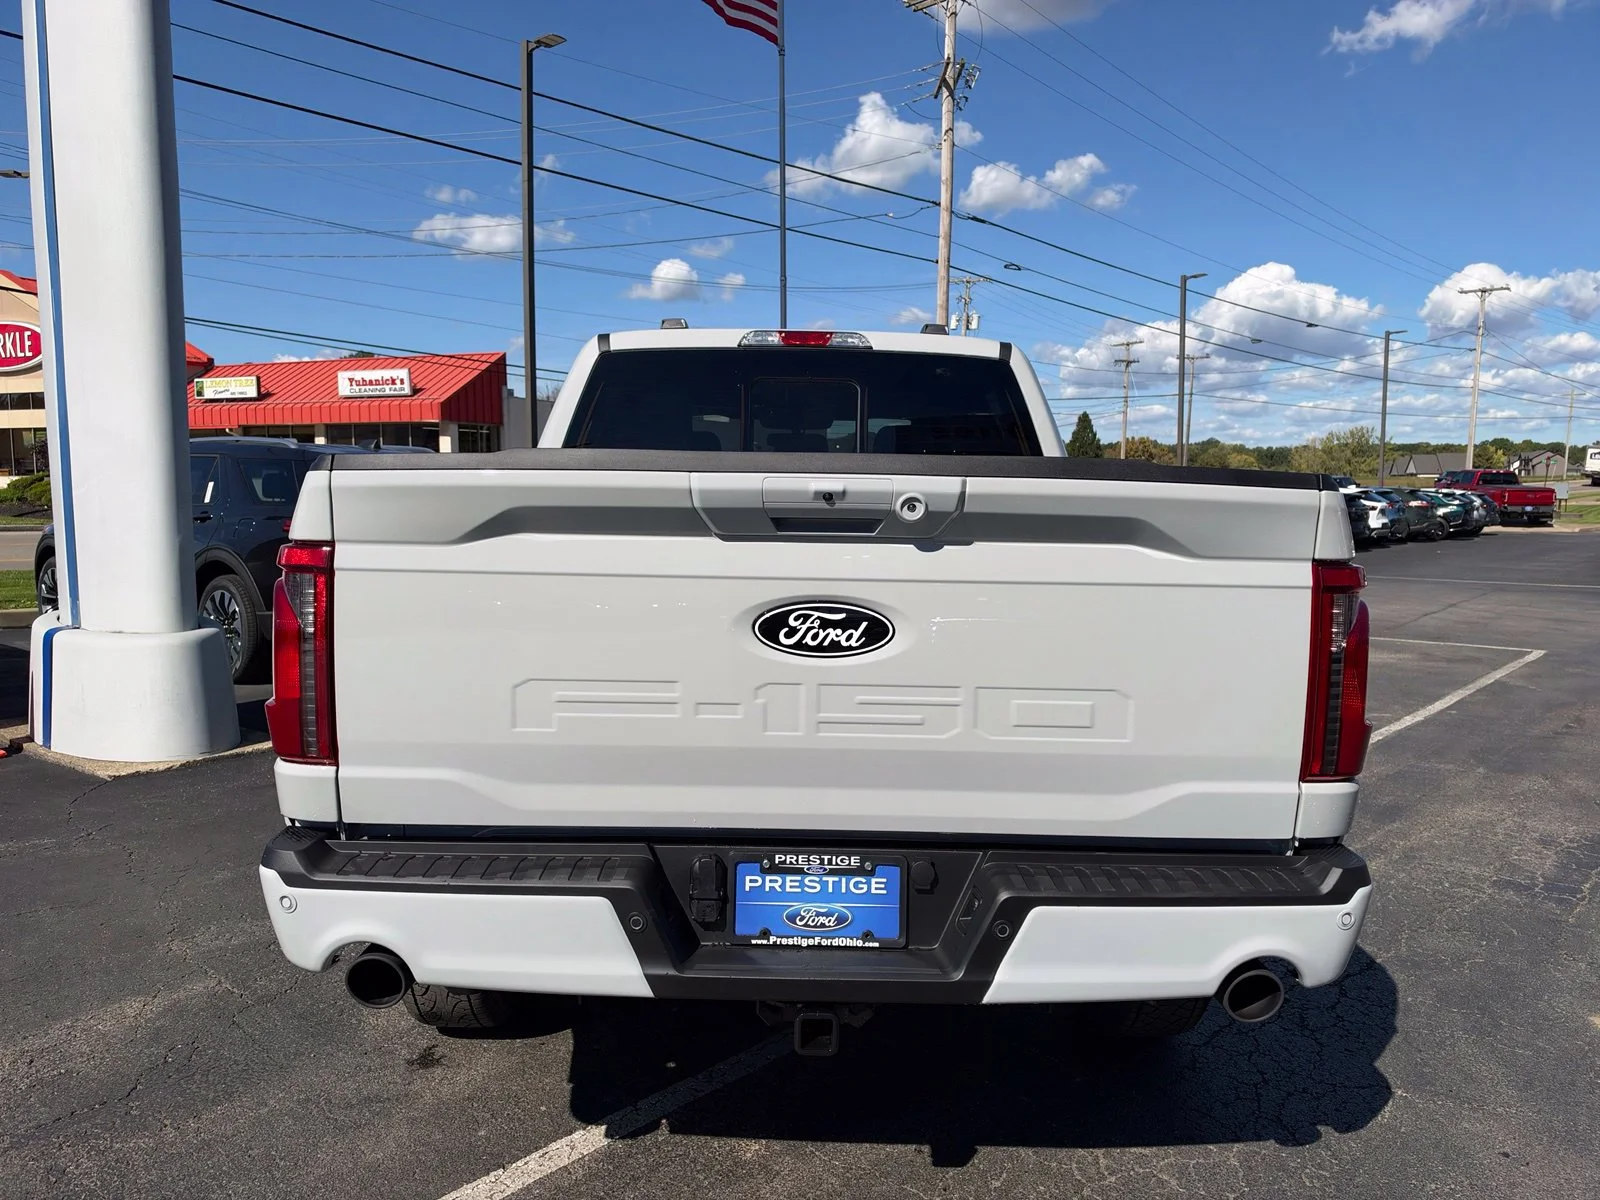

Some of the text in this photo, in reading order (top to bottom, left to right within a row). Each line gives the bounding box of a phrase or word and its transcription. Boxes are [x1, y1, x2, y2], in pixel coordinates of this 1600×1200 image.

[205, 379, 255, 389] LEMON TREE
[347, 376, 405, 387] Yuhanick's
[779, 610, 868, 647] Ford
[511, 678, 1134, 743] F-150
[774, 854, 861, 866] PRESTIGE
[744, 875, 888, 894] PRESTIGE
[795, 906, 839, 927] Ford
[751, 936, 880, 948] www.PrestigeFordOhio.com
